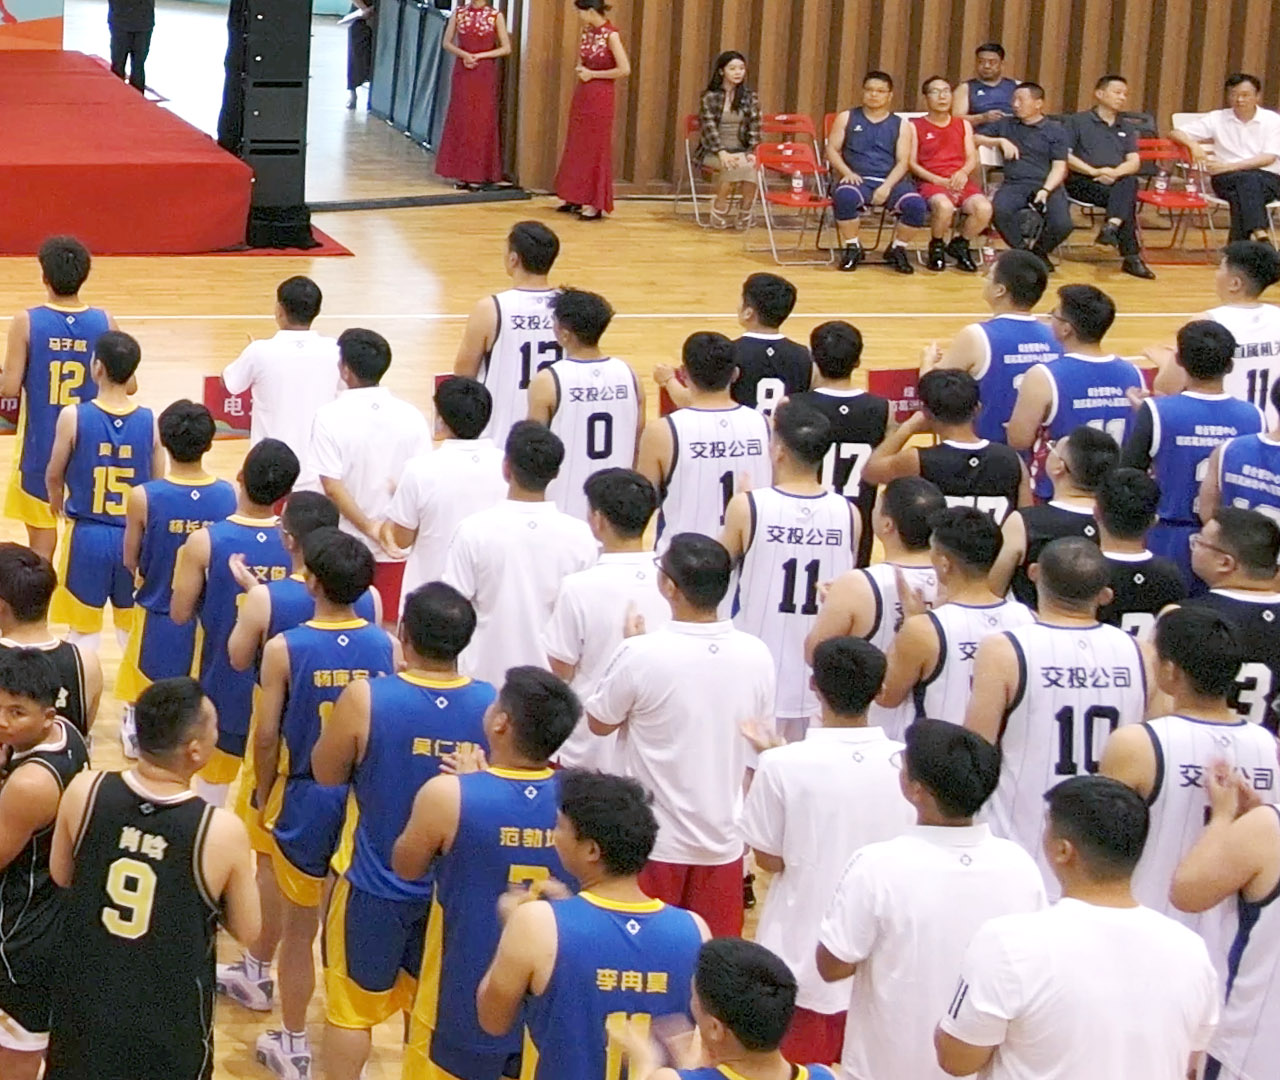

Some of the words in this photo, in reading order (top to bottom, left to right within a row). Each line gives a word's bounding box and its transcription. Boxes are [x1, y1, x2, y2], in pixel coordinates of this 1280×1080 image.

[48, 360, 85, 406] 12
[519, 340, 564, 390] 12
[568, 384, 629, 403] 交投公司
[586, 411, 613, 460] 0
[689, 439, 764, 460] 交投公司
[92, 466, 135, 516] 15
[821, 442, 873, 499] 17
[766, 524, 843, 547] 交投公司
[778, 557, 821, 615] 11
[1041, 665, 1131, 690] 交投公司
[1054, 704, 1121, 776] 10
[1179, 764, 1274, 791] 交公司
[101, 857, 158, 940] 9
